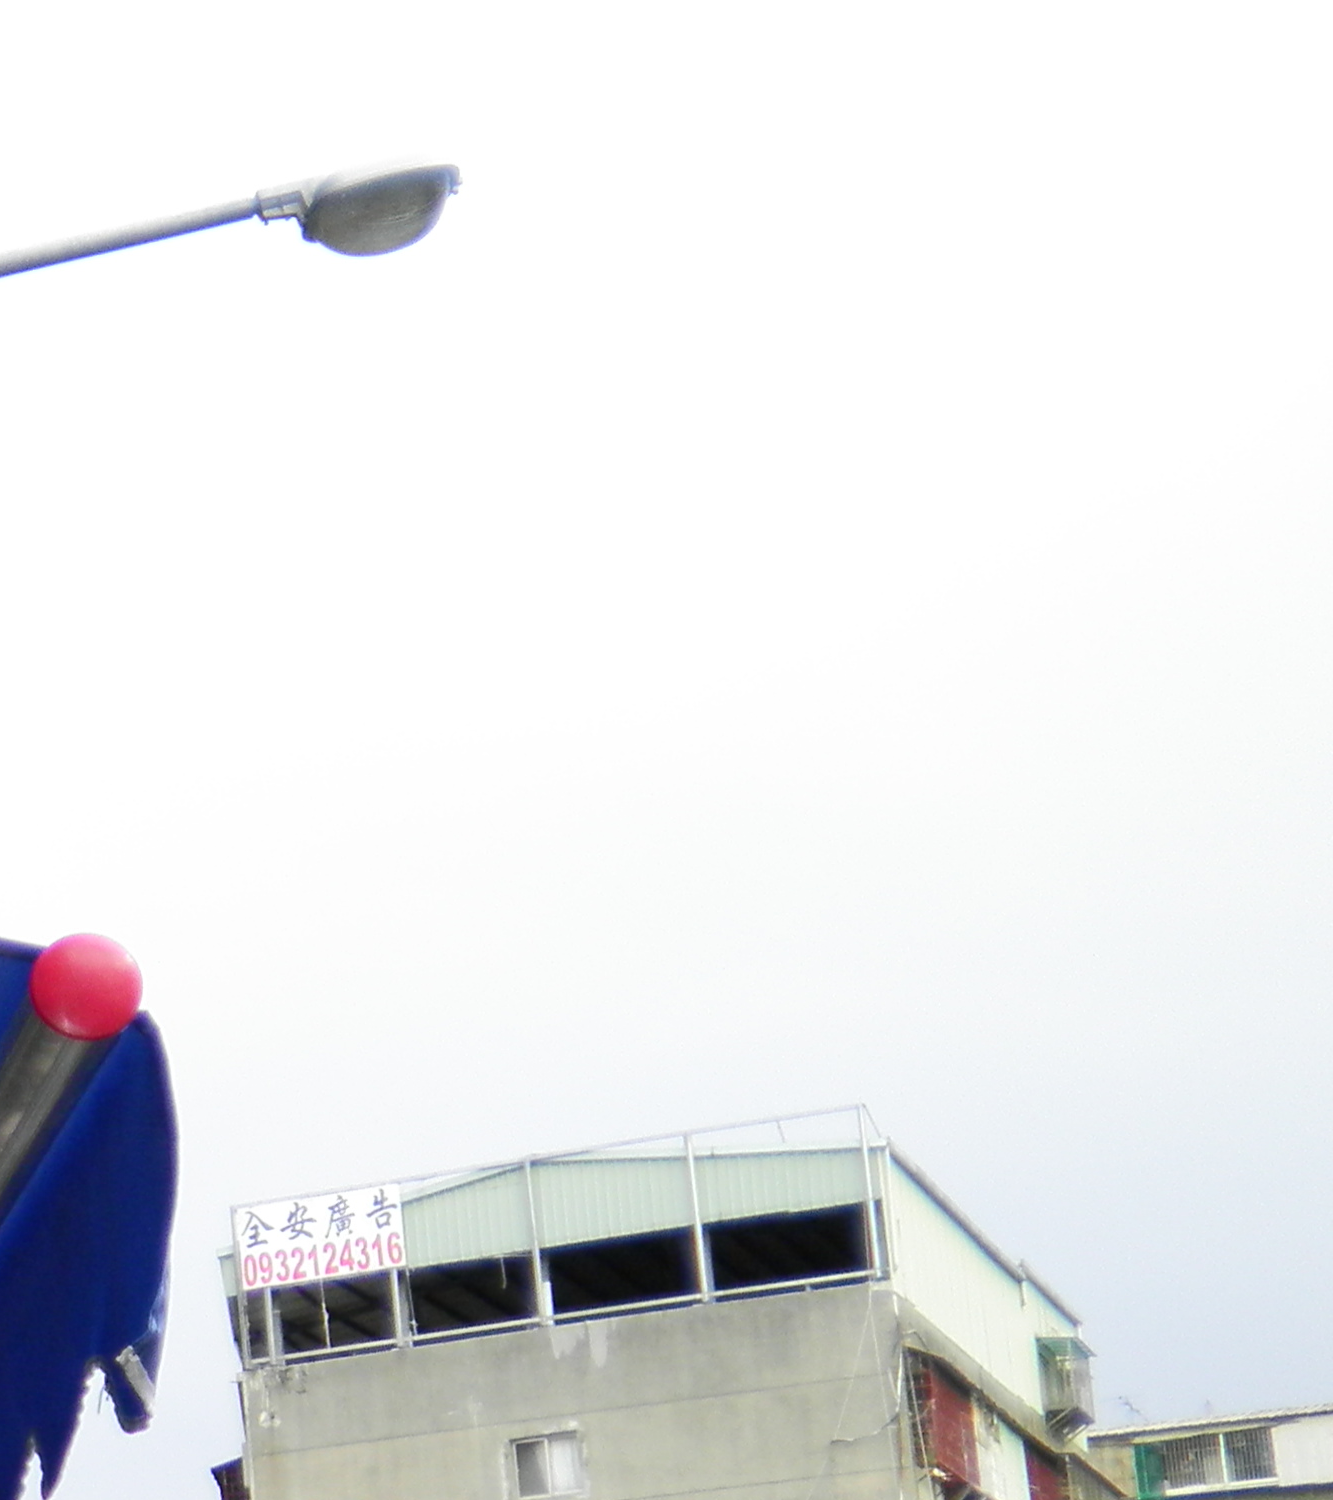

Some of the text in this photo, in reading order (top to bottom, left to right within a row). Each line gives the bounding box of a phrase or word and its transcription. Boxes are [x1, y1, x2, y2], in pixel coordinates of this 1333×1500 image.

[241, 1188, 398, 1248] 全安廣告
[243, 1230, 403, 1288] 0932124316
